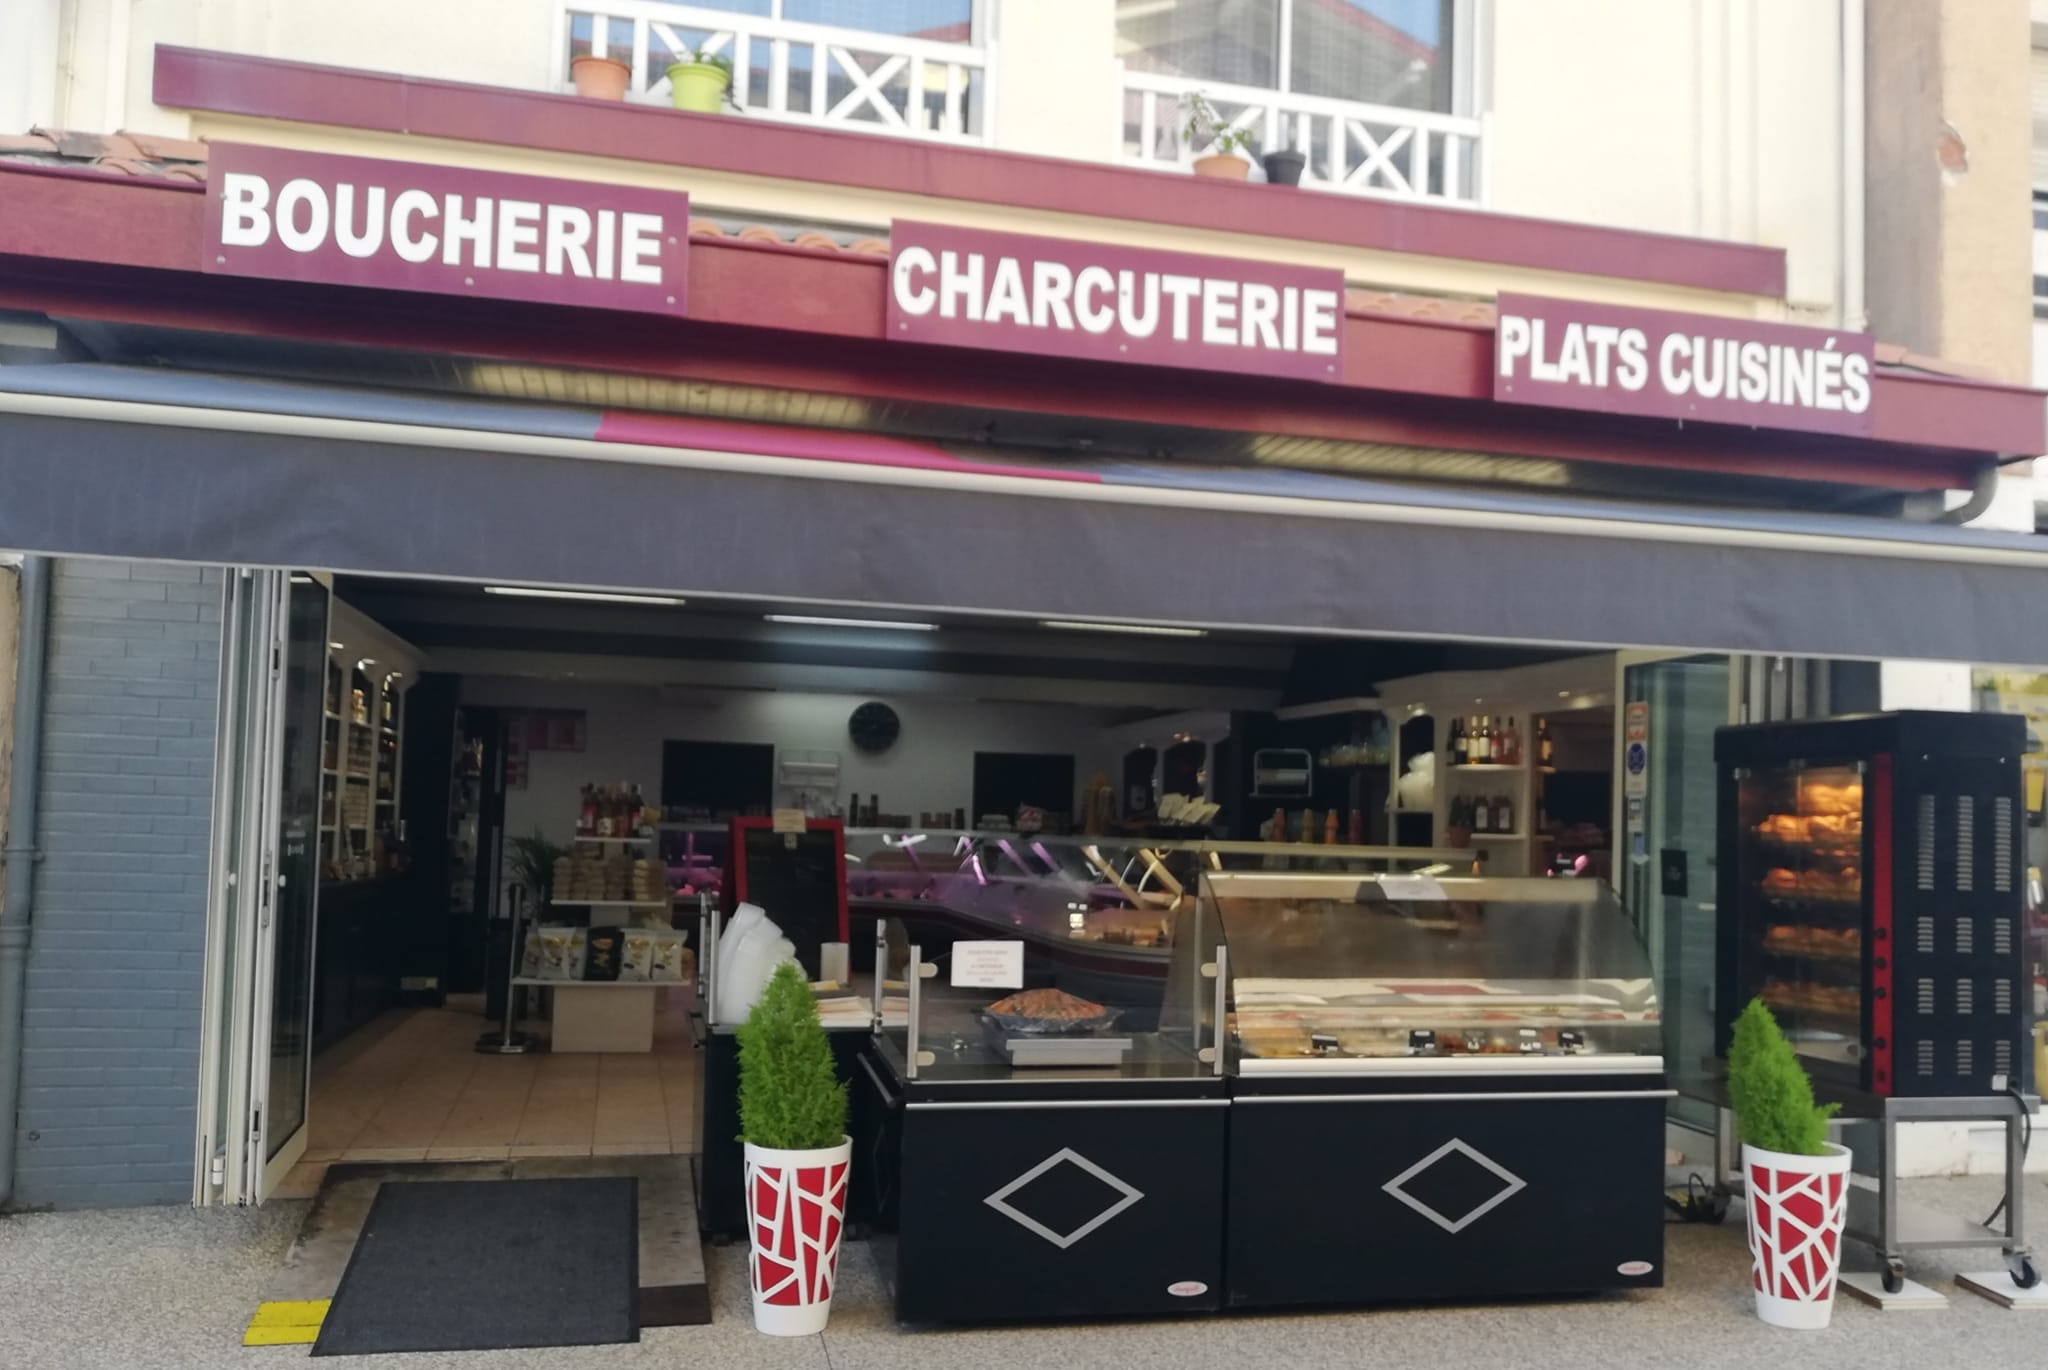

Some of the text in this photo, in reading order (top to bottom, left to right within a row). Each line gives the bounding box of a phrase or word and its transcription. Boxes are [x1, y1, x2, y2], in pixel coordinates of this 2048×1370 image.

[220, 172, 663, 285] BOUCHERIE
[893, 246, 1338, 356] CHARCUTERIE
[1500, 315, 1871, 414] PLATS CUISINÉS
